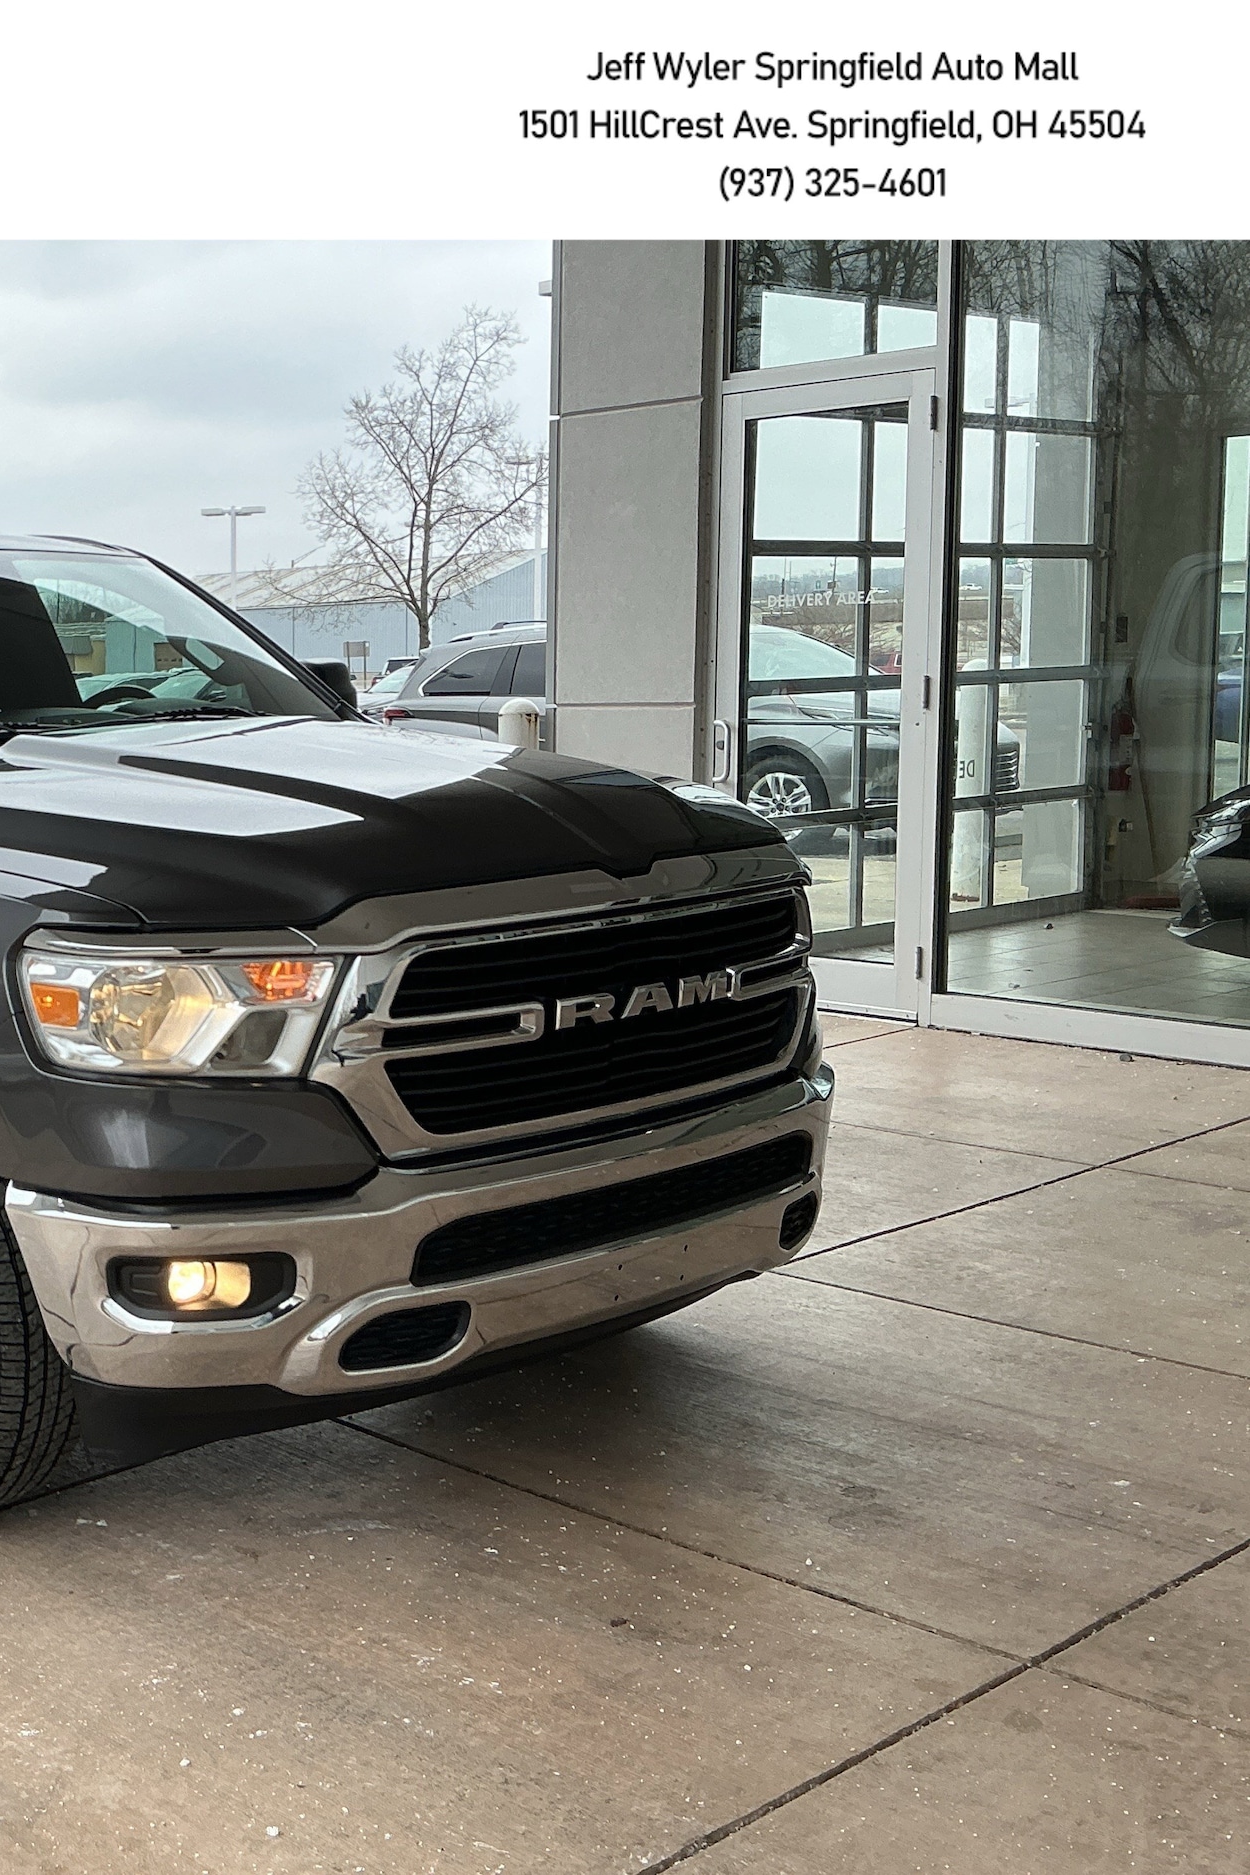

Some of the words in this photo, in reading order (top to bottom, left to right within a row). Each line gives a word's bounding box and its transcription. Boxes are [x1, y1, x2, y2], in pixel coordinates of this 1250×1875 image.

[767, 592, 833, 608] DELIVERY
[836, 590, 875, 606] AREA
[555, 971, 728, 1030] RAM
